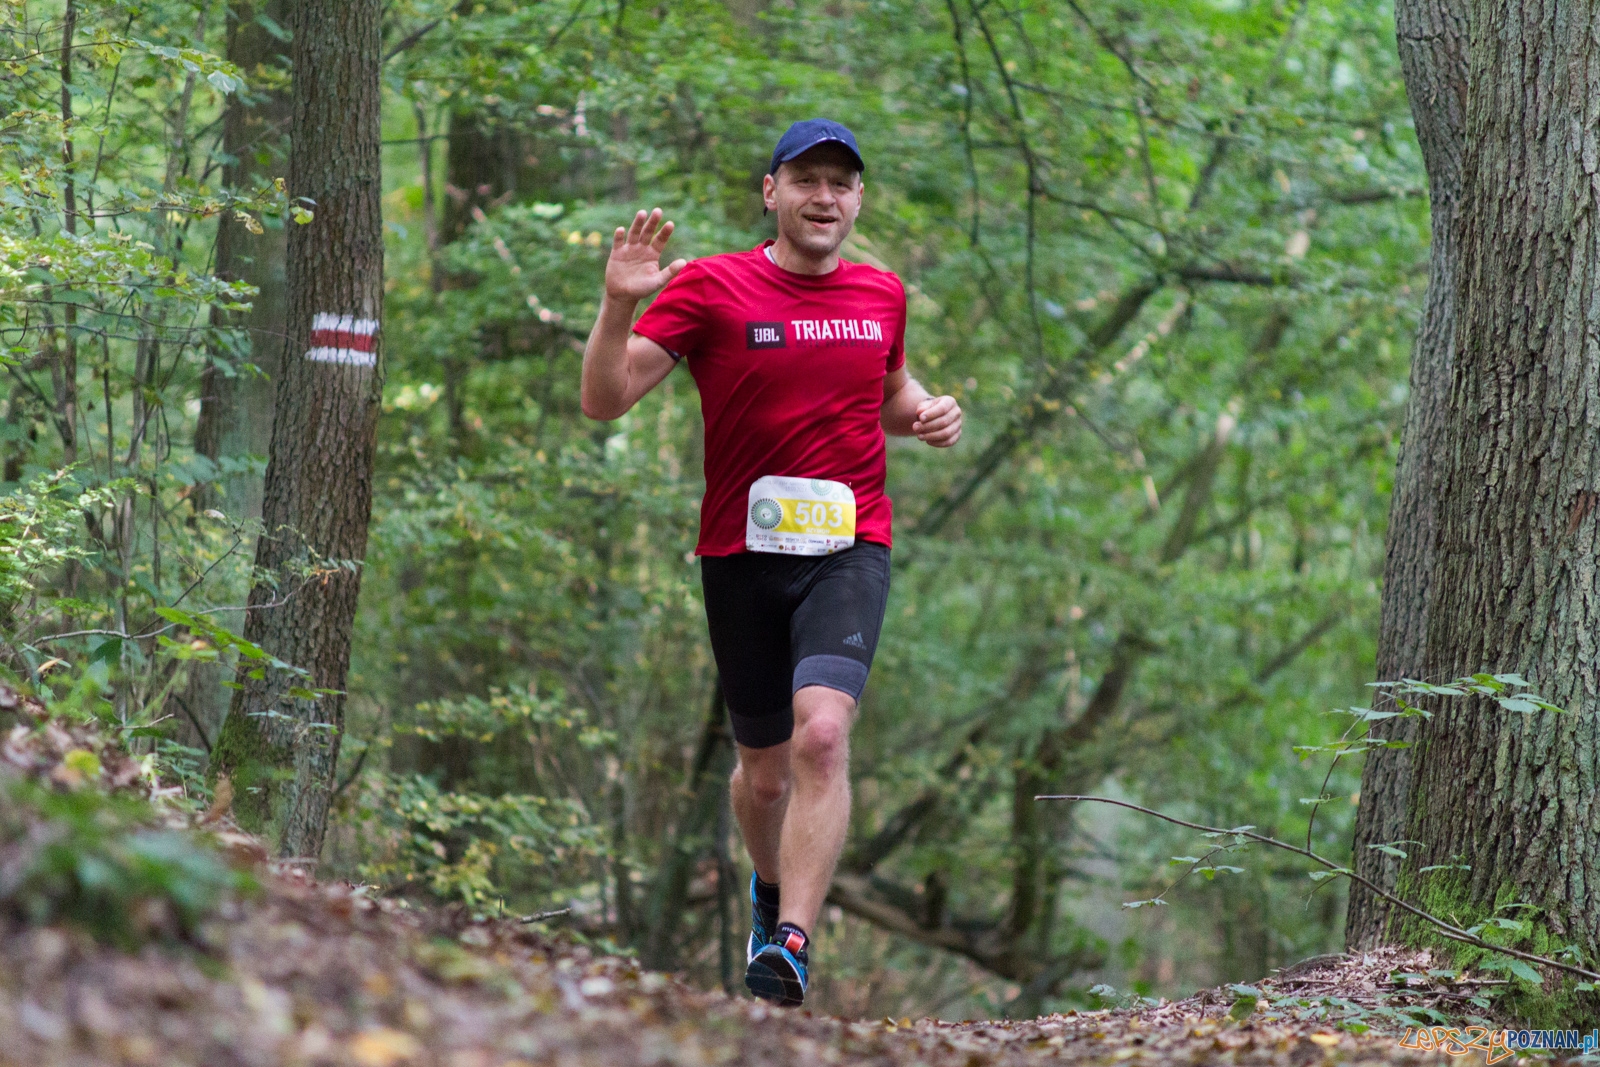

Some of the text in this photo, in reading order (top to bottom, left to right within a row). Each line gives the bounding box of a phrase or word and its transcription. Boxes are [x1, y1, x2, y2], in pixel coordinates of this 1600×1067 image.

[753, 319, 883, 343] JBL TRIATHLON
[794, 502, 843, 528] 503
